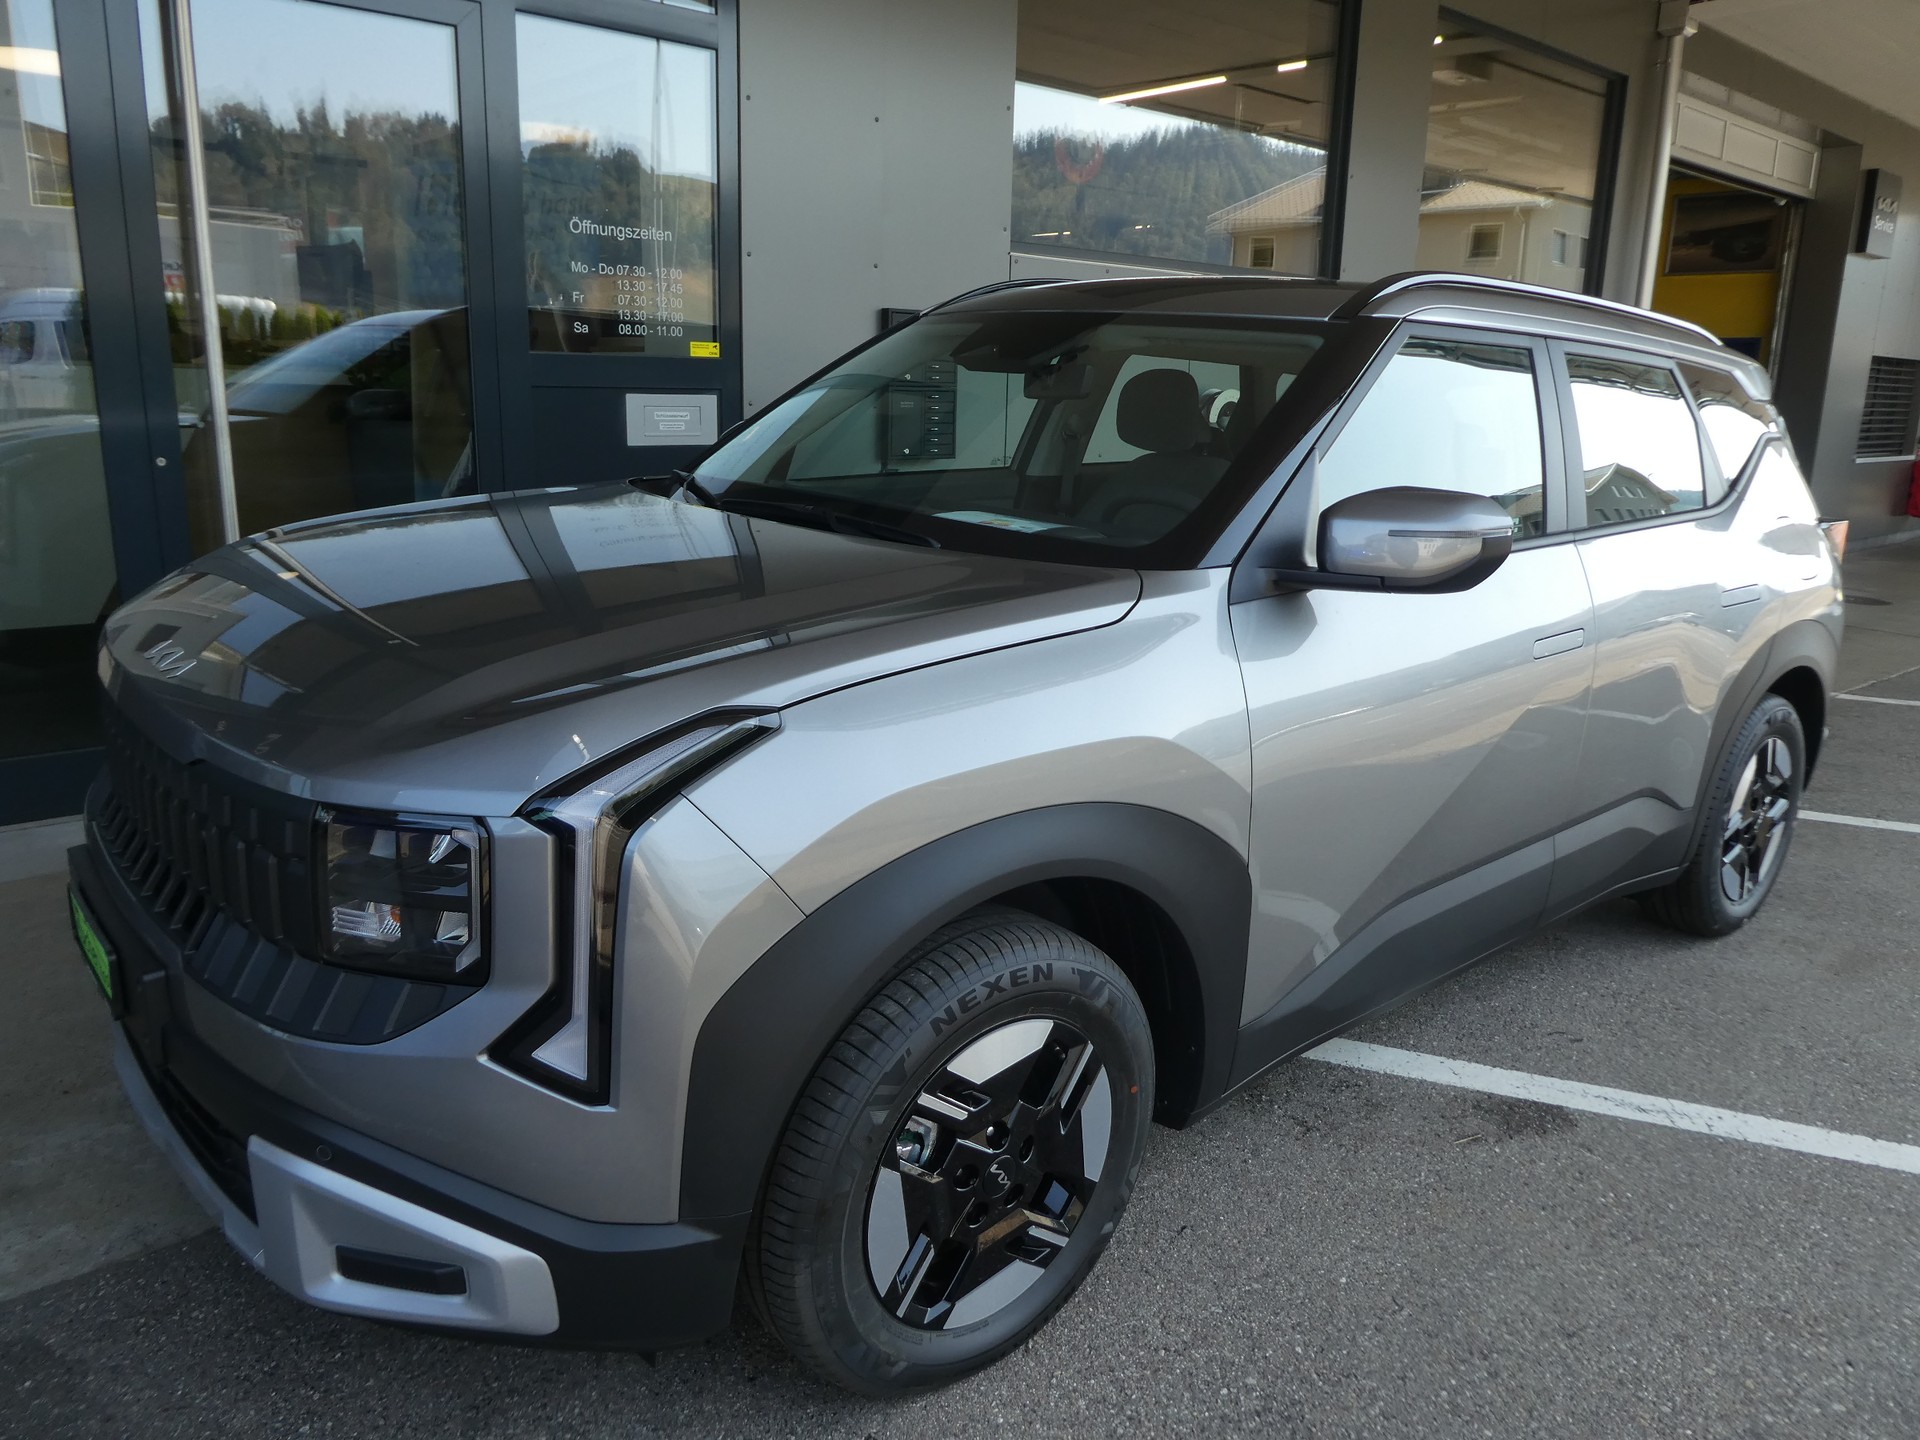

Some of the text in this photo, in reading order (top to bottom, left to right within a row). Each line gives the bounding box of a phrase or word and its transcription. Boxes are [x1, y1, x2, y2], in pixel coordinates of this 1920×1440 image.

[569, 216, 673, 242] Öffnungszeiten
[571, 261, 588, 274] Mo
[599, 263, 614, 275] Do
[616, 265, 646, 277] 07.30
[656, 268, 683, 280] 12.00
[617, 280, 646, 291] 13.30
[656, 283, 683, 294] 17.45
[572, 292, 585, 303] Fr
[617, 294, 647, 306] 07.30
[656, 297, 683, 309] 12.00
[618, 310, 647, 321] 13.30
[657, 312, 684, 323] 17.00
[574, 322, 589, 333] Sa
[618, 323, 648, 335] 08.00
[656, 326, 683, 337] 11.00
[928, 962, 1054, 1037] NEXEN
